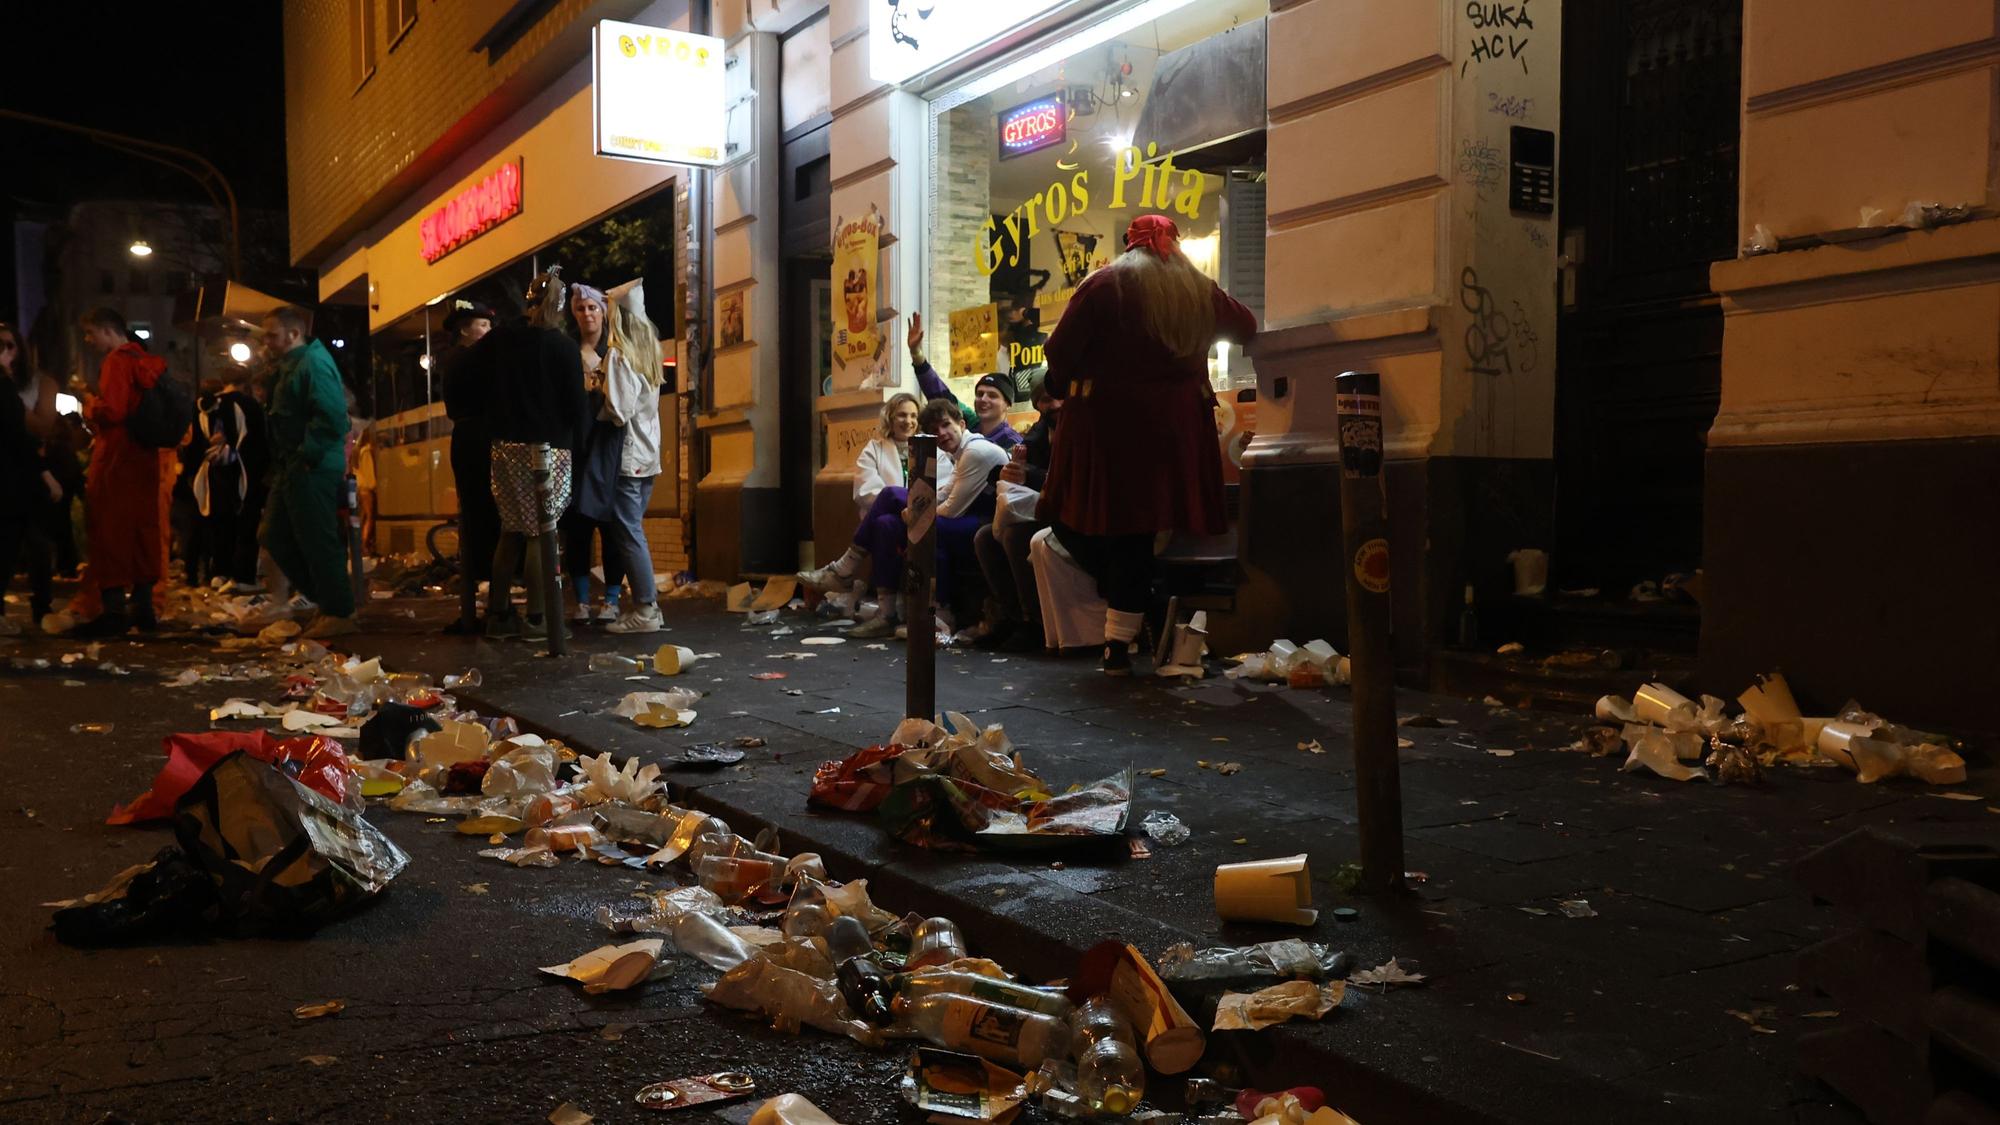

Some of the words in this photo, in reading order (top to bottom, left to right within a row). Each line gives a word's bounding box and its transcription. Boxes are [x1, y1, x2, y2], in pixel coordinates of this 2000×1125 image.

[618, 34, 709, 67] GYROS
[1471, 34, 1528, 63] HCV
[1005, 108, 1056, 142] GYROS
[972, 170, 1089, 278] Gyros
[1108, 142, 1205, 220] Pita
